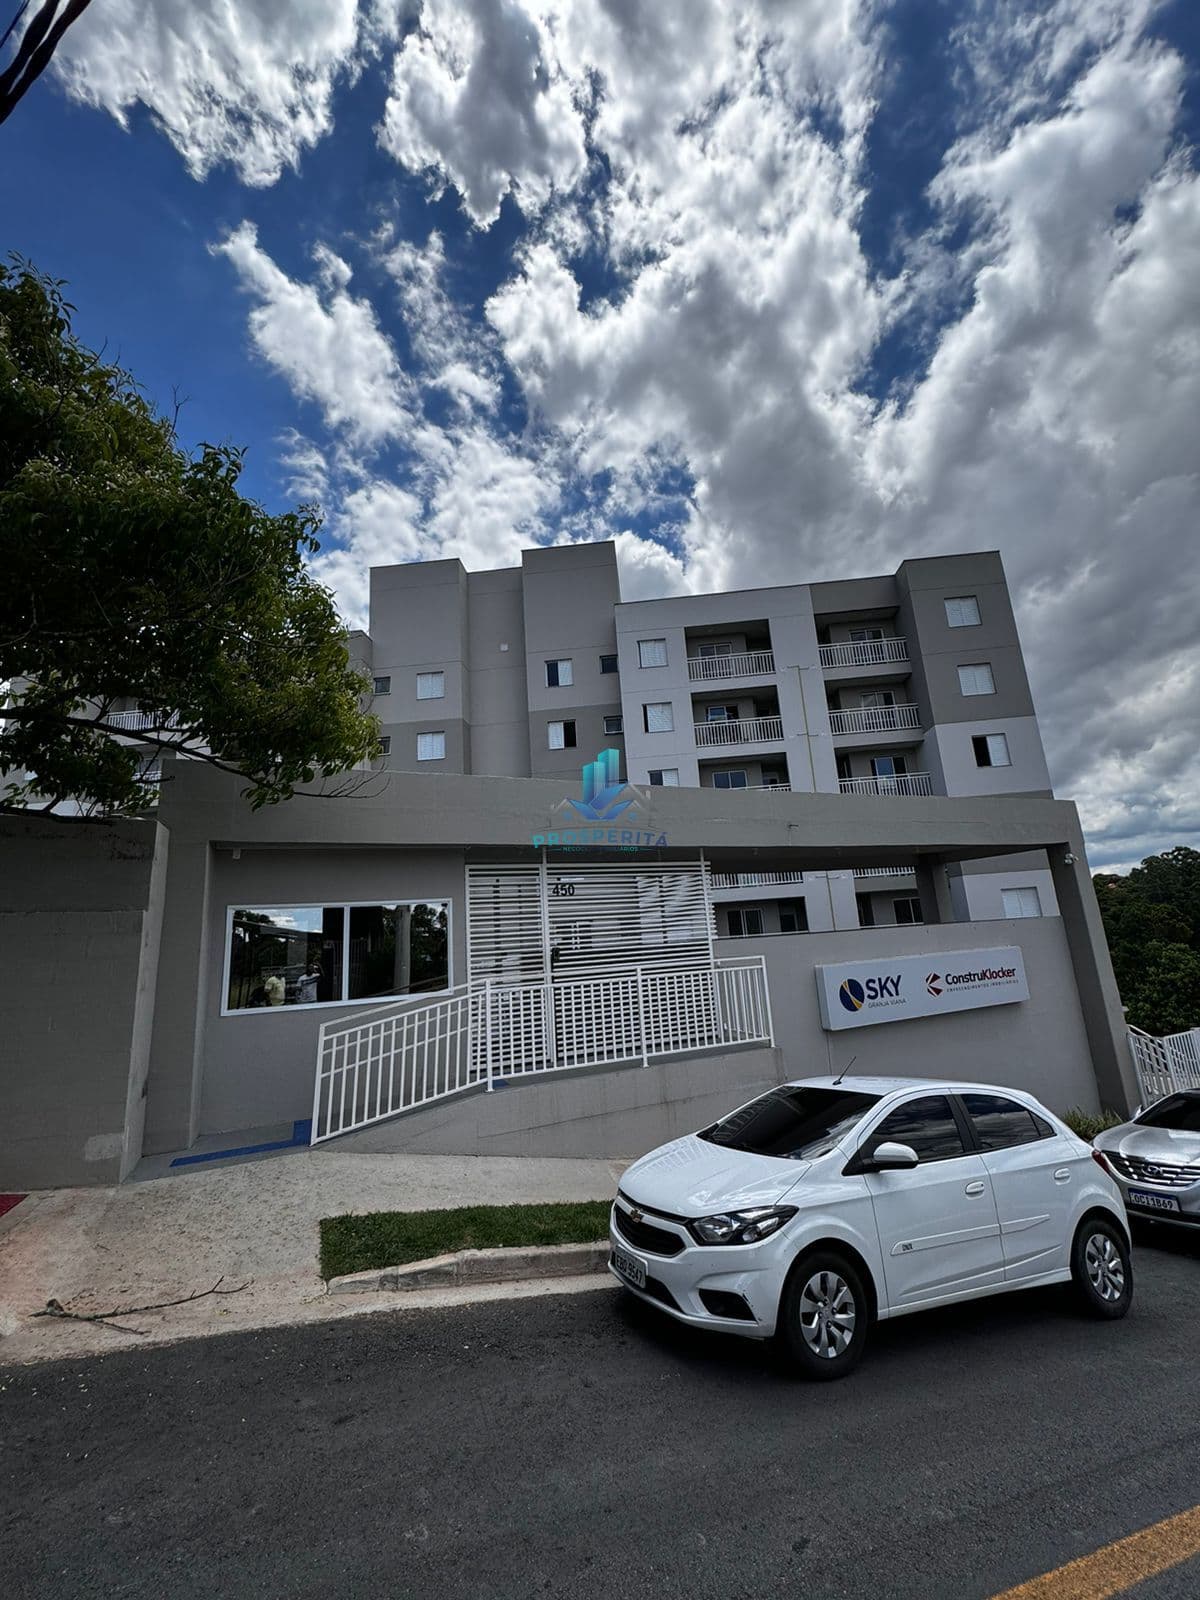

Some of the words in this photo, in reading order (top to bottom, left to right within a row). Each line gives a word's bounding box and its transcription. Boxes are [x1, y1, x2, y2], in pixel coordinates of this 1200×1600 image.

[552, 883, 575, 896] 450
[945, 966, 1016, 986] ConstruKlocker
[865, 974, 902, 1001] SKY
[868, 1000, 889, 1009] GRANJA
